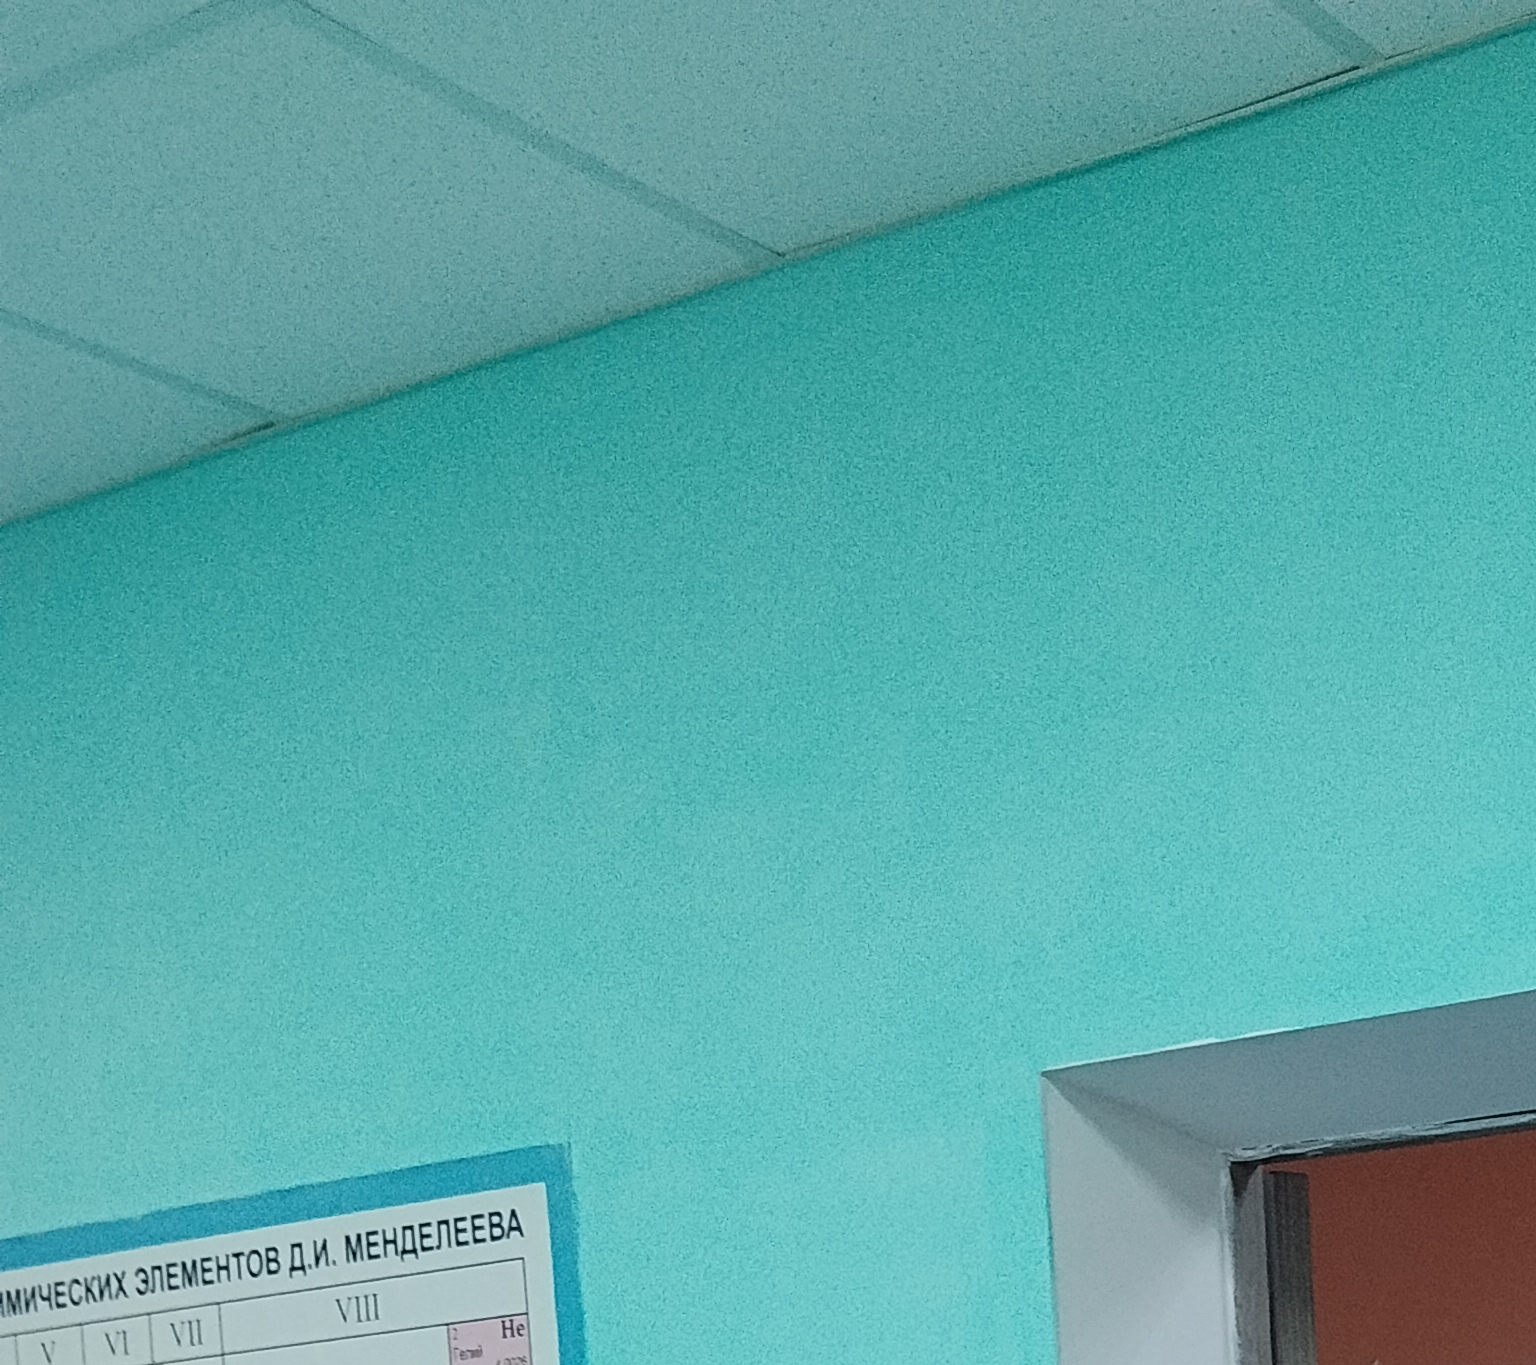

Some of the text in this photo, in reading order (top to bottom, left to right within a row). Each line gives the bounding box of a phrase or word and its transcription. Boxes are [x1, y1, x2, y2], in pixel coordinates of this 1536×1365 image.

[134, 1246, 281, 1296] ЭЛЕМЕНТОВ
[288, 1238, 337, 1278] Д.И.
[344, 1208, 525, 1263] МЕНДЕЛЕЕВА
[335, 1293, 380, 1324] VIII
[105, 1330, 129, 1356] VI
[170, 1319, 204, 1347] VII
[501, 1319, 525, 1339] He
